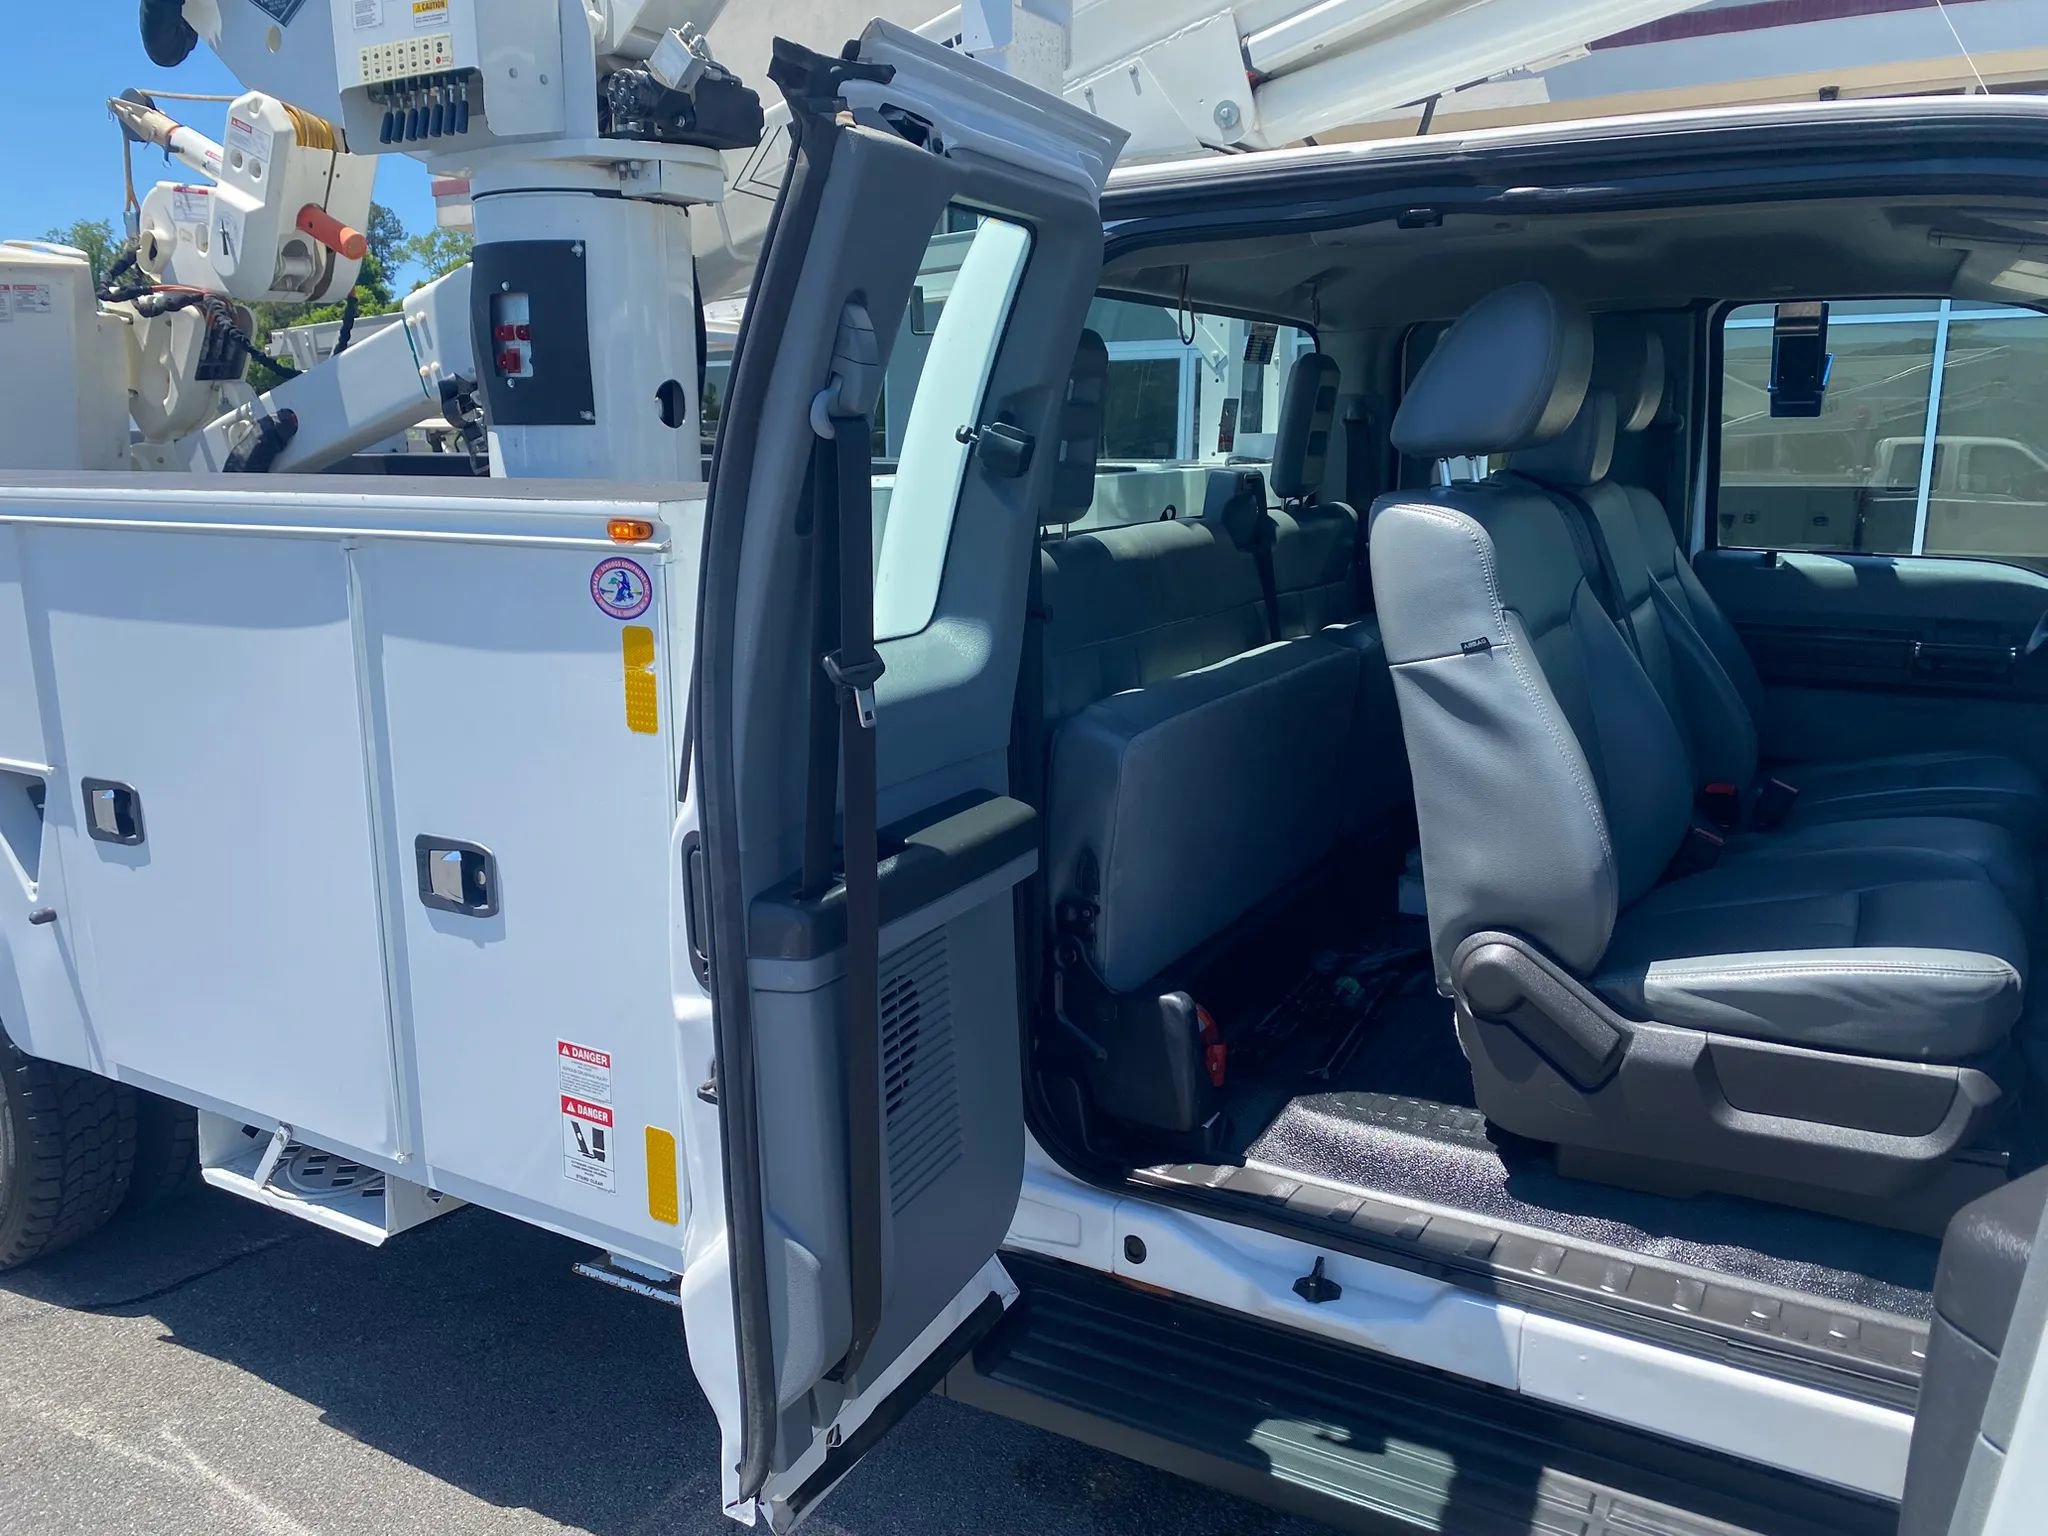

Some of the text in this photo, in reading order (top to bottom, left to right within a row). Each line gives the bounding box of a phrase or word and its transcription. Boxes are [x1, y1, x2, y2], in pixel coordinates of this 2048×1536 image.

[421, 1, 445, 12] CAUTION
[1463, 638, 1487, 650] AIRBAG
[571, 1047, 608, 1066] DANGER
[577, 1104, 608, 1123] DANGER
[590, 1178, 604, 1186] CLEAR
